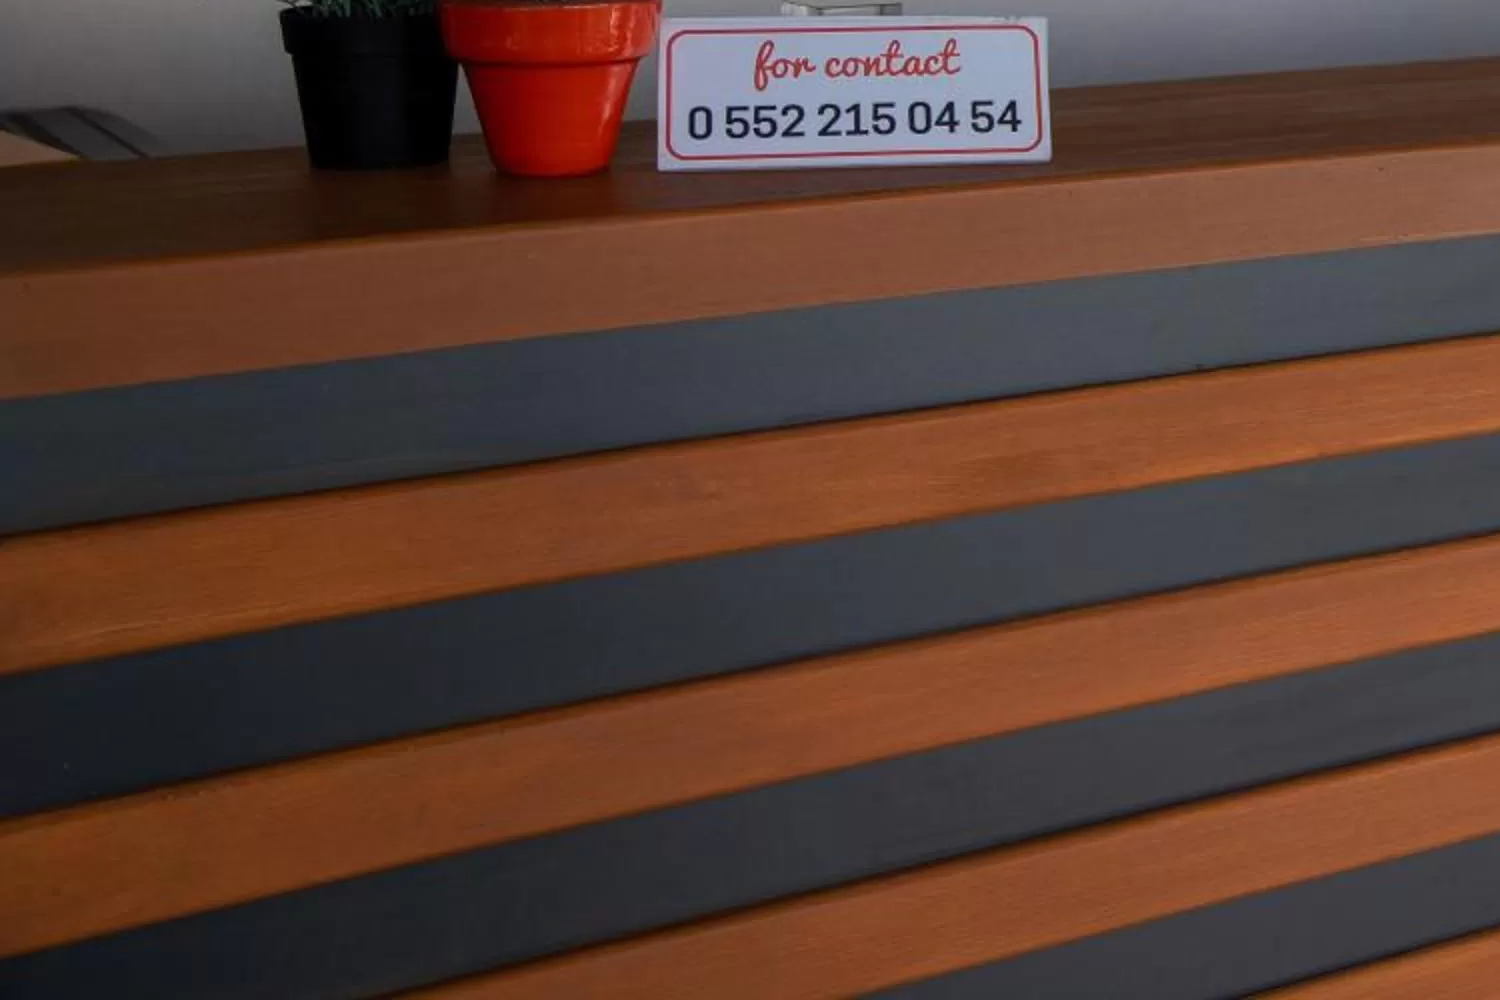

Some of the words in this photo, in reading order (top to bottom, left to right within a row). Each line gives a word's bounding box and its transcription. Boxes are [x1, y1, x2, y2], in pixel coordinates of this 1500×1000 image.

[754, 40, 816, 91] for
[824, 38, 961, 79] contact
[688, 105, 713, 140] 0
[724, 104, 806, 139] 552
[816, 102, 897, 138] 215
[907, 100, 959, 135] 04
[970, 100, 1022, 134] 54
